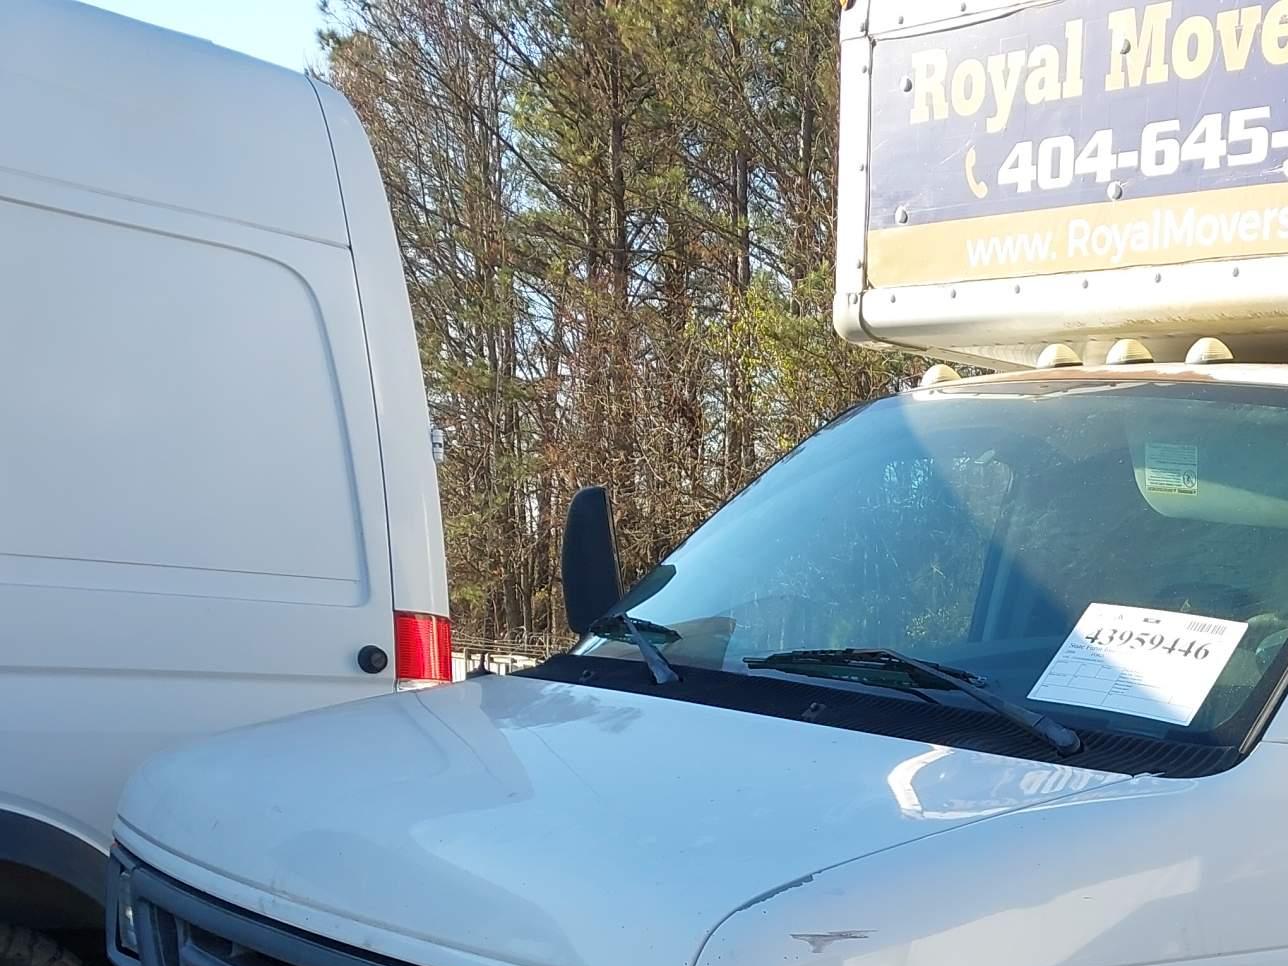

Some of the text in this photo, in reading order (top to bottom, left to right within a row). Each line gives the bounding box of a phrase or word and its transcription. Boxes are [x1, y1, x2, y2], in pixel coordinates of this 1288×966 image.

[909, 18, 1083, 134] Royal
[966, 232, 1056, 267] www.
[1085, 627, 1213, 661] 43959446
